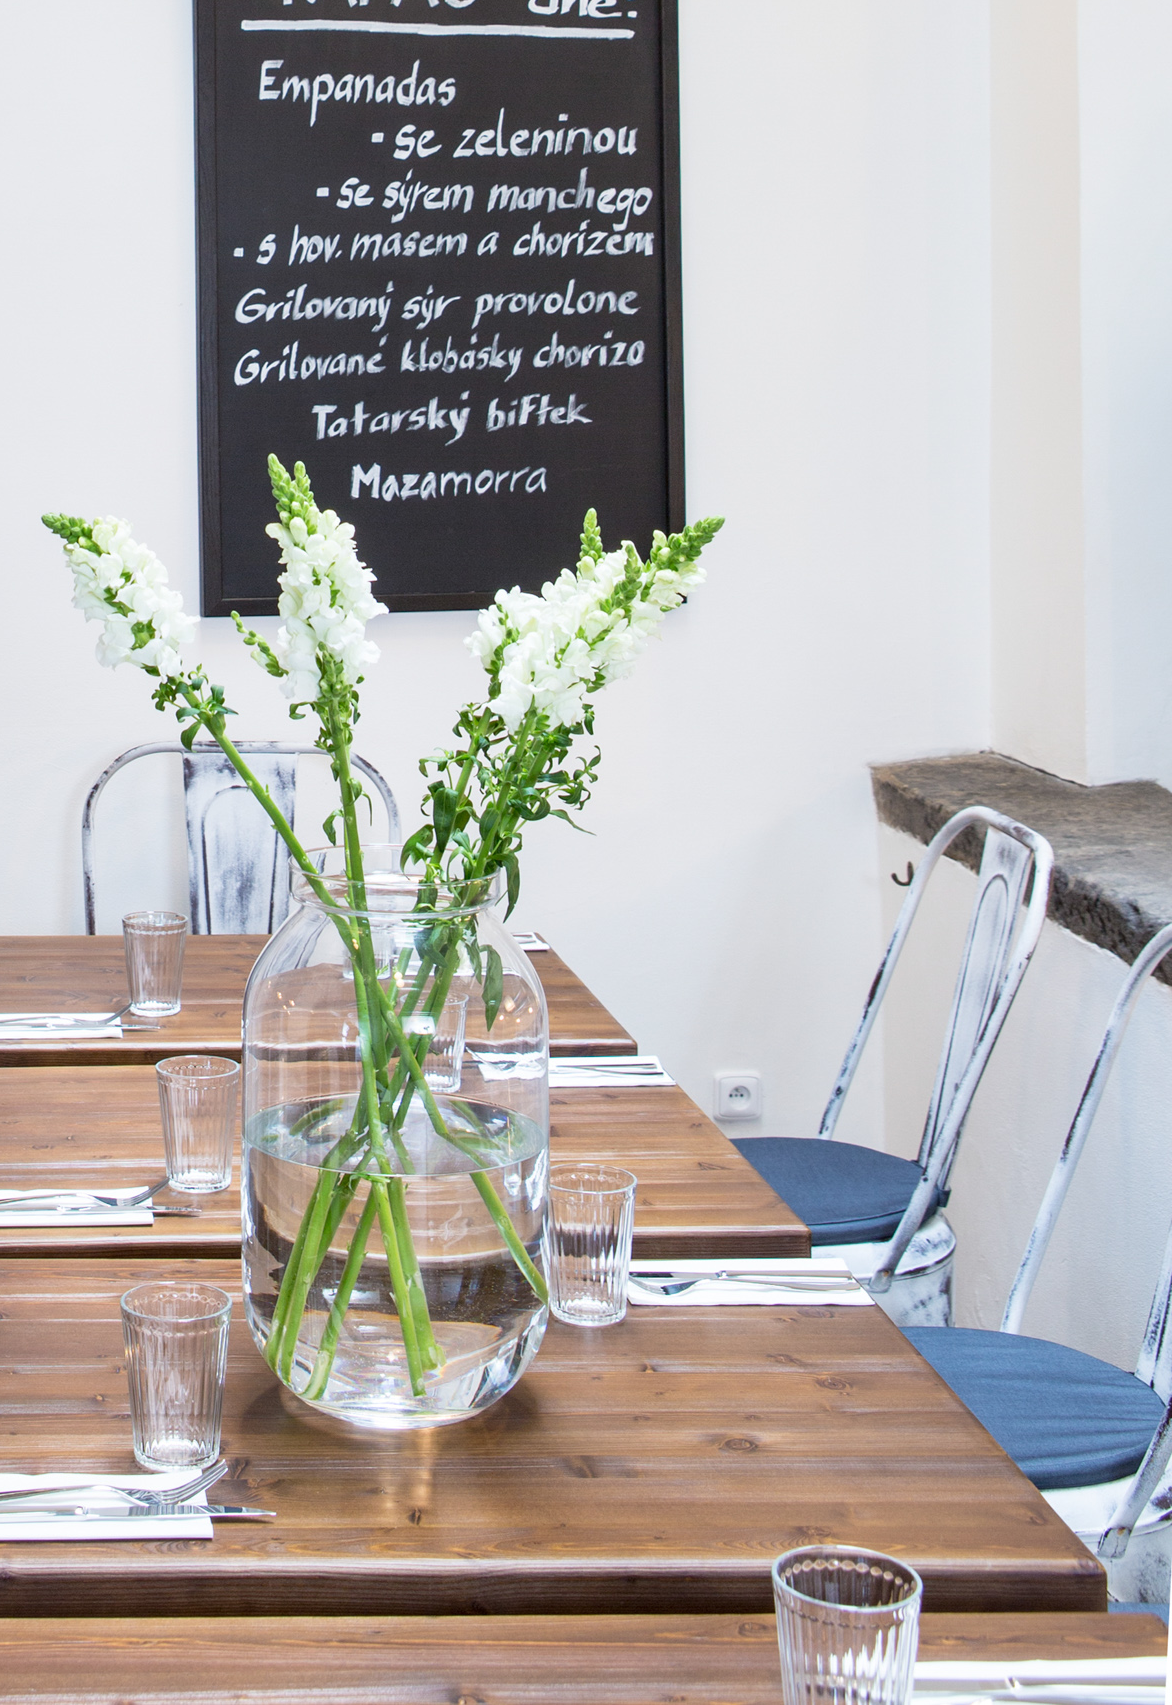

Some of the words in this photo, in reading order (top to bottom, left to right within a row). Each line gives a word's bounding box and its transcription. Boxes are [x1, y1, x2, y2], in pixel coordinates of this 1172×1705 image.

[259, 59, 456, 127] Empanadas
[453, 108, 638, 158] zeleninou
[382, 169, 474, 223] sýrem
[487, 167, 653, 232] manchego
[289, 224, 342, 266] hov.
[350, 231, 467, 261] masem
[477, 232, 499, 256] a
[513, 219, 654, 257] chorizem
[235, 281, 394, 332] Grilovaný
[401, 285, 461, 329] sýr
[472, 279, 639, 329] provolone
[234, 334, 388, 386] Grilované
[401, 333, 522, 382] klobásky
[533, 331, 645, 368] chorizo
[312, 391, 470, 446] Tatarský
[351, 463, 546, 501] Mazamorra
